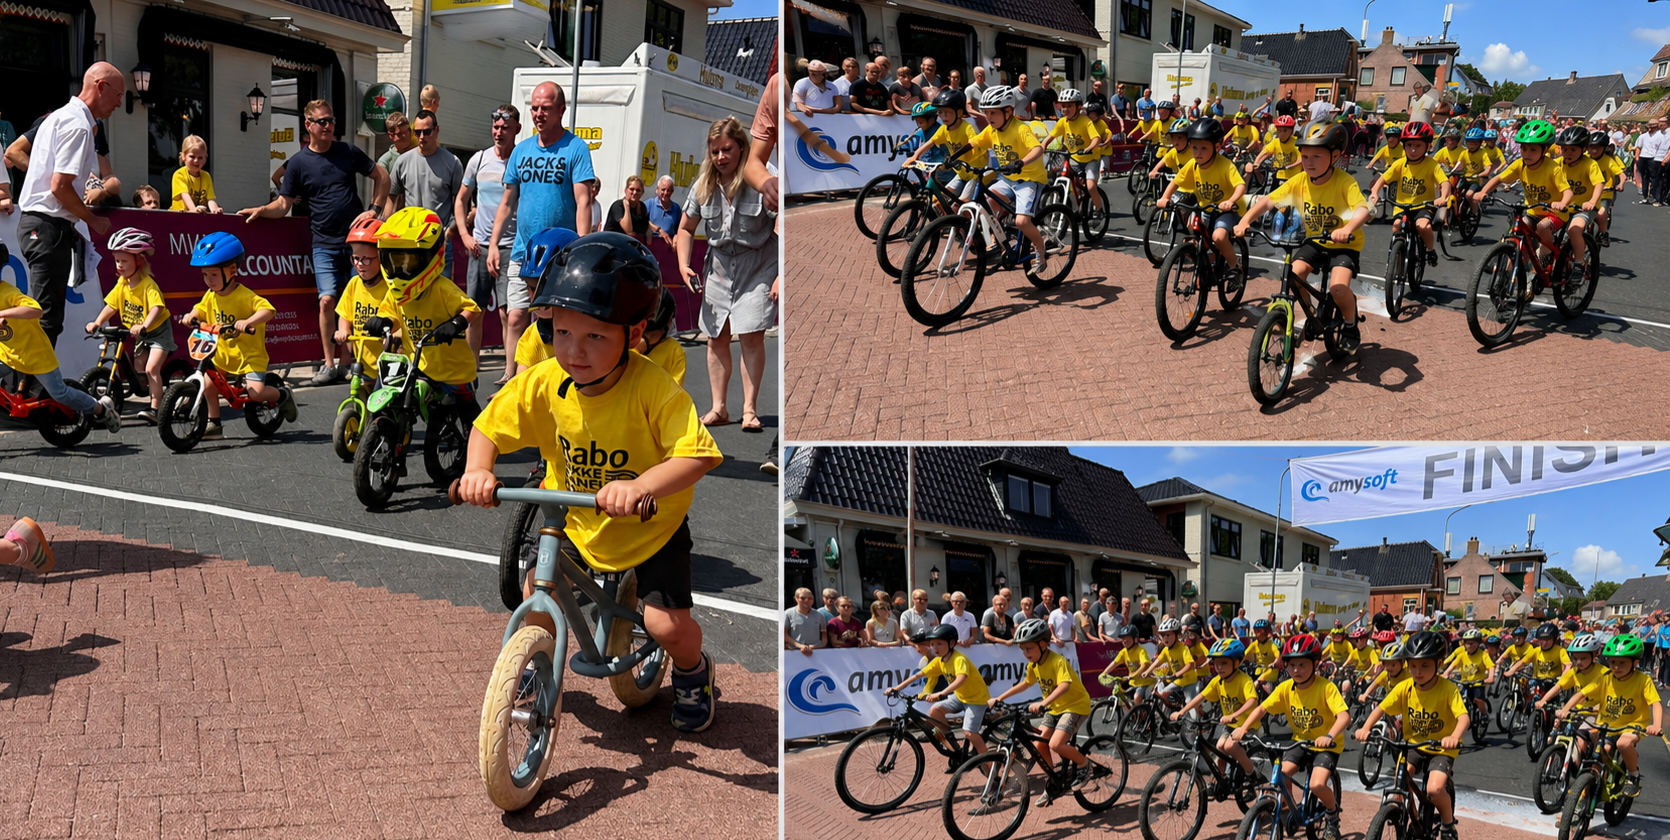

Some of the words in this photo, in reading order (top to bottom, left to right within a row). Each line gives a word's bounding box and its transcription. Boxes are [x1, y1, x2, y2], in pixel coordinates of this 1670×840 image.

[518, 156, 566, 170] JACK&
[519, 170, 565, 184] ONES
[1304, 202, 1334, 215] Rabo
[235, 255, 314, 277] COUNTA
[214, 309, 235, 323] abo
[191, 340, 215, 353] 16
[388, 362, 400, 376] 1
[1329, 468, 1398, 495] amysoft
[1291, 706, 1318, 716] Rabo
[1408, 707, 1438, 719] Rabo
